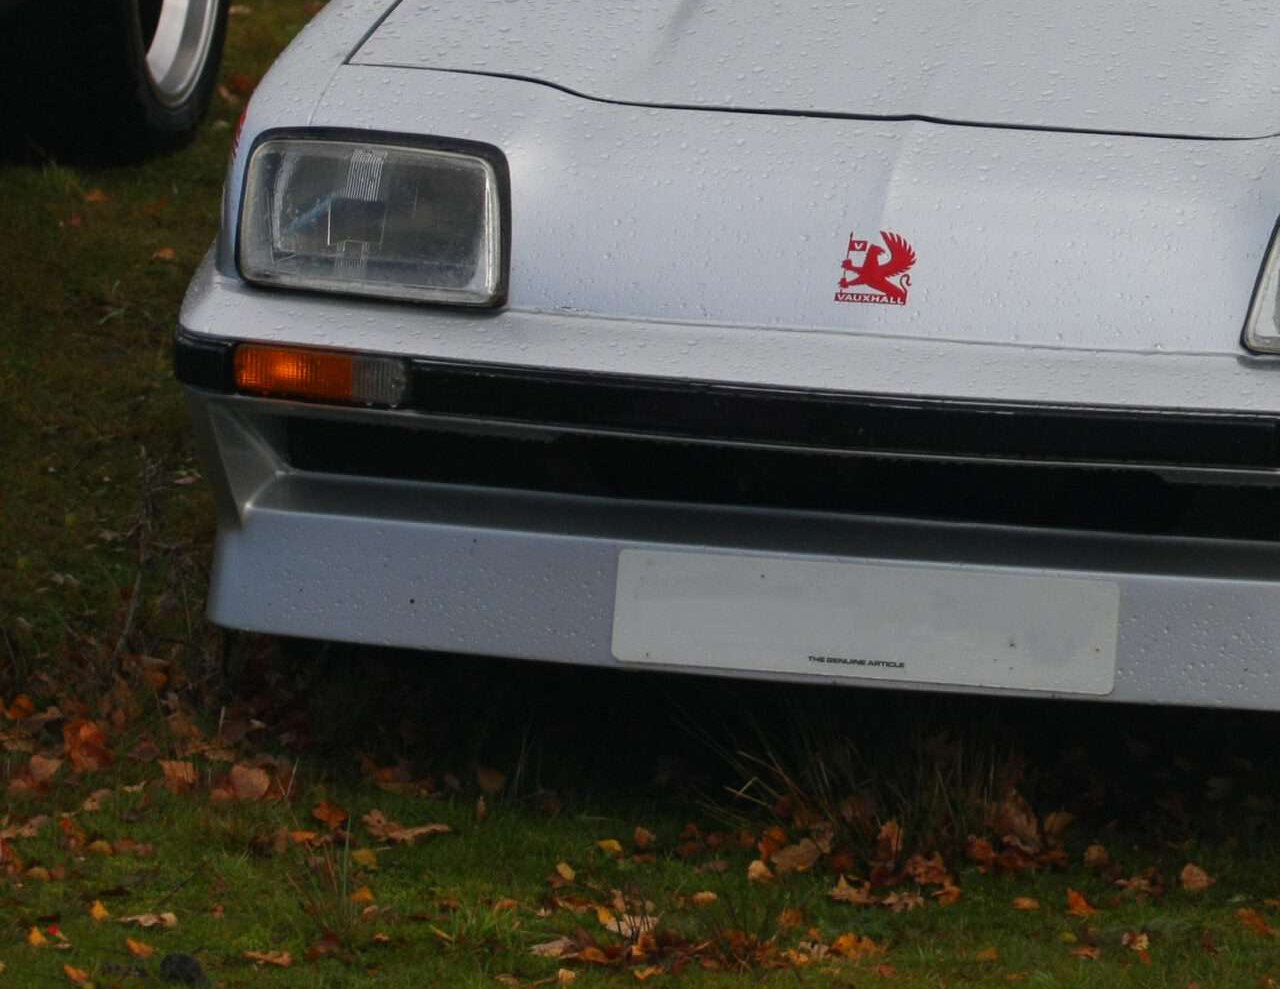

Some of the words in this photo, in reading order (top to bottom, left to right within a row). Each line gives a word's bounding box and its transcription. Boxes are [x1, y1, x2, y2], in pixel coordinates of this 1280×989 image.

[836, 292, 905, 305] VAUXHALL
[808, 655, 825, 663] THE
[867, 659, 905, 668] ARTICLE
